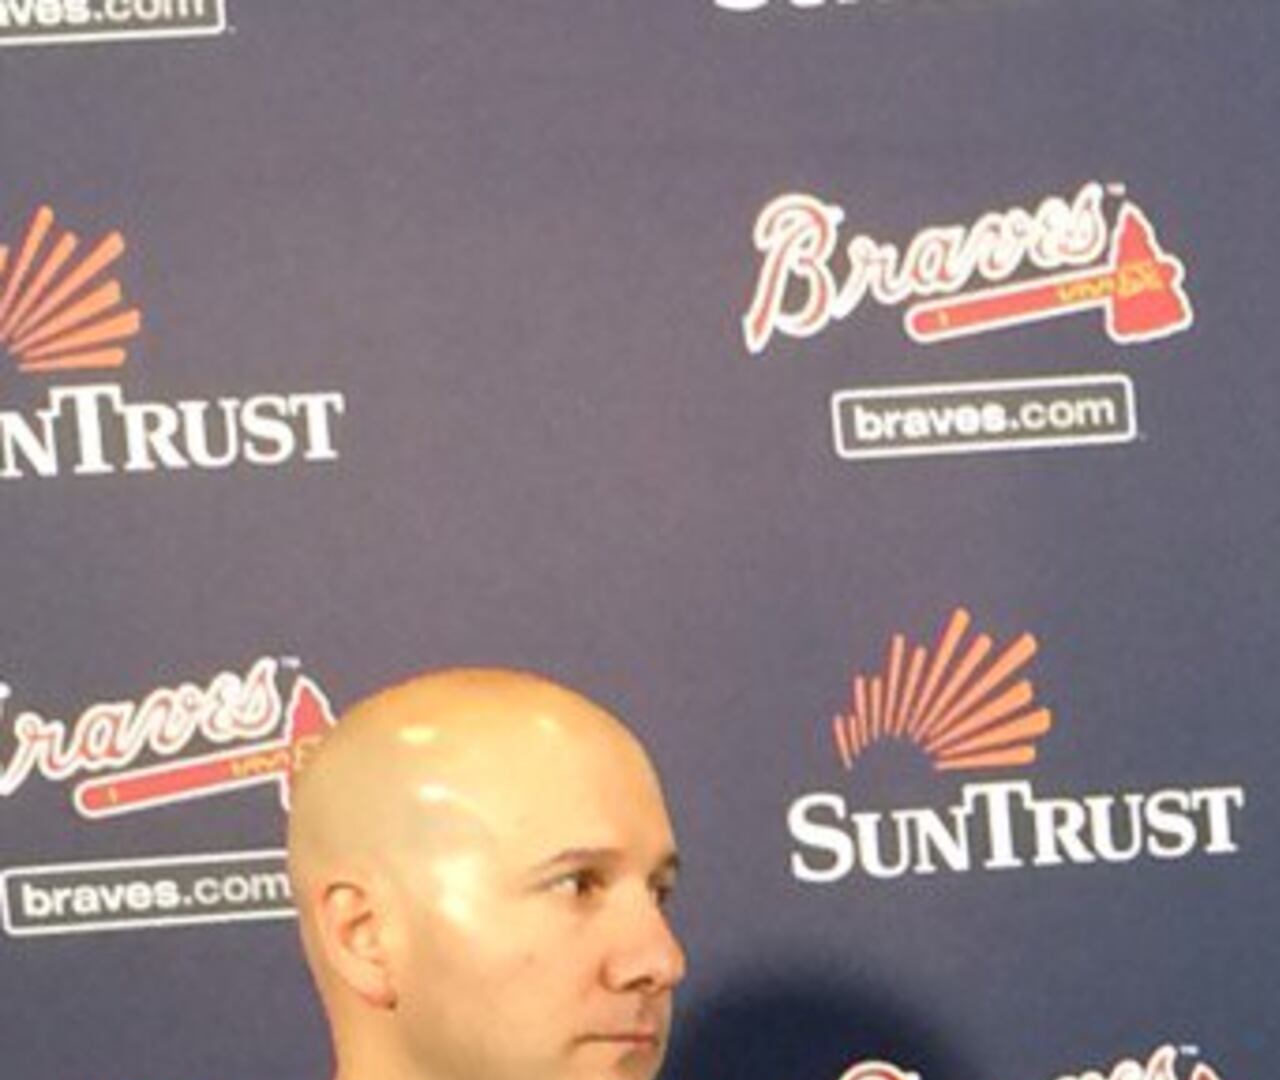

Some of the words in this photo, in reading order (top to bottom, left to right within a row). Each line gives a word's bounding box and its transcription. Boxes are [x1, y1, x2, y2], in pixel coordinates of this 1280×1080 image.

[0, 0, 205, 27] ves.com
[742, 182, 1106, 354] Braves
[853, 398, 1116, 442] braves.com
[0, 656, 282, 797] raves
[20, 872, 292, 918] braves.com
